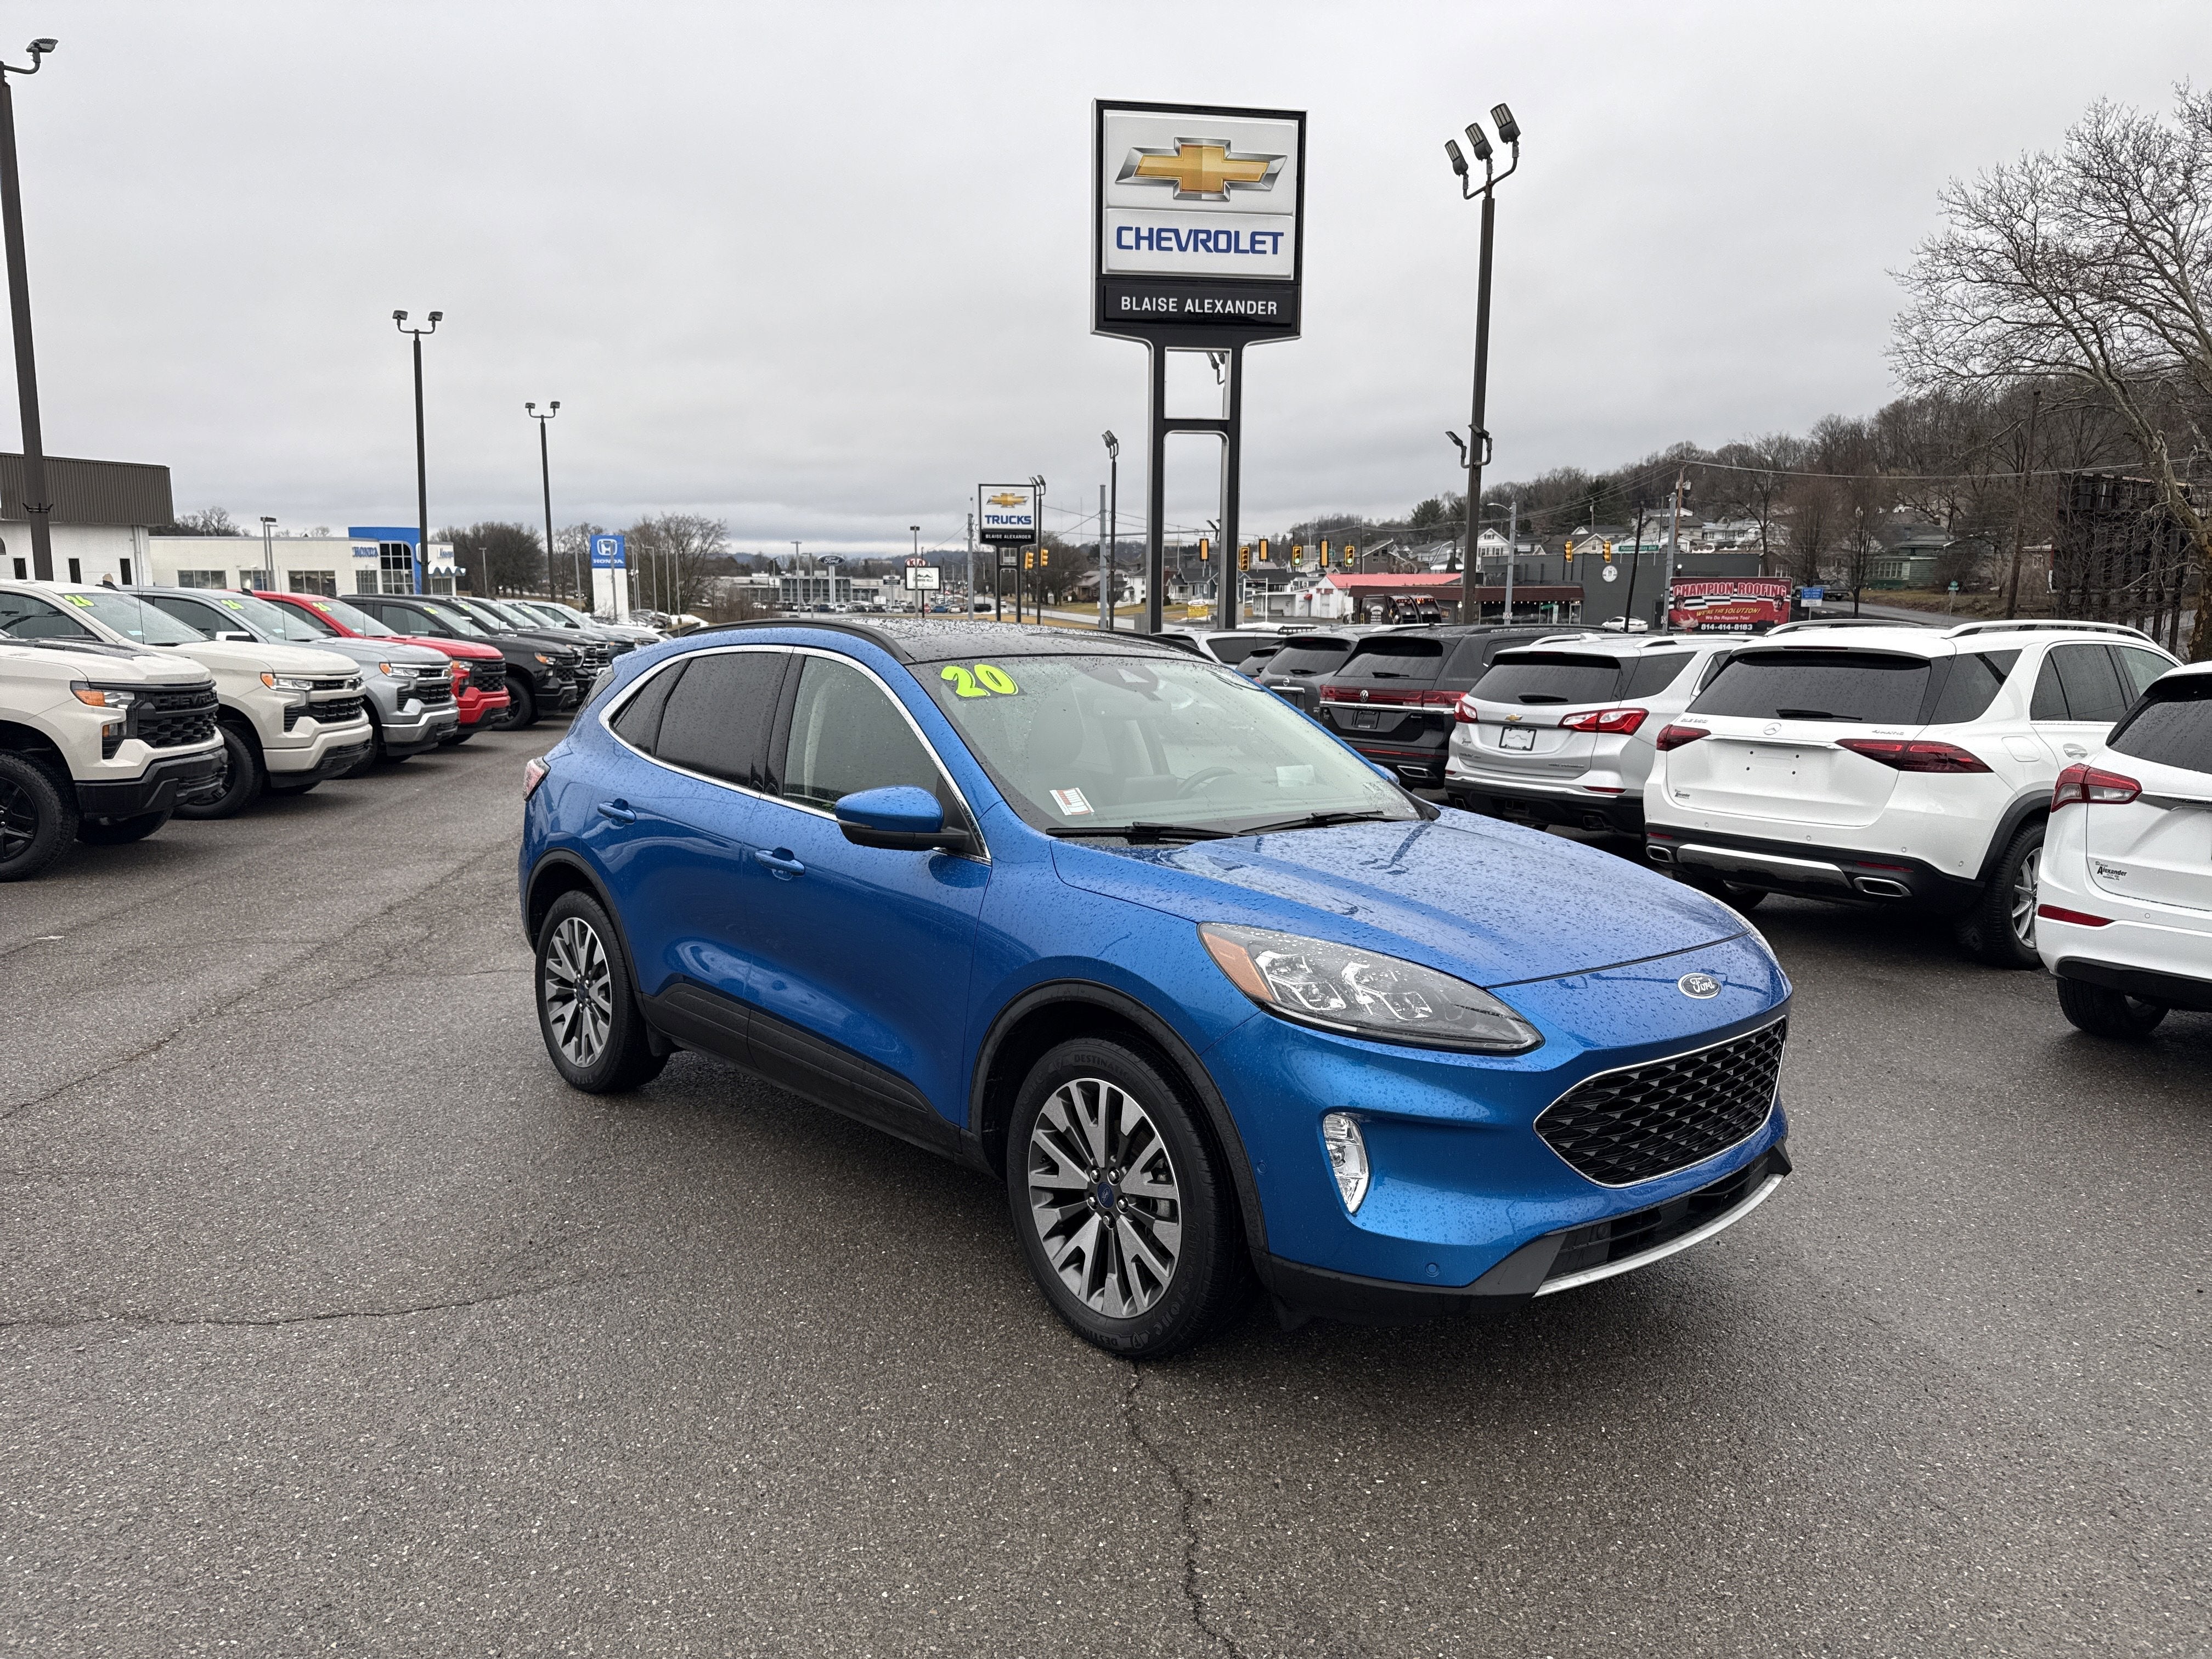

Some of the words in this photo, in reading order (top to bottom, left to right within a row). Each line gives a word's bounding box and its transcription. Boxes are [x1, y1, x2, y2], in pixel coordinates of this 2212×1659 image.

[1116, 226, 1284, 255] CHEVROLET
[1121, 296, 1178, 312] BLAISE
[1184, 299, 1277, 315] ALEXANDER
[985, 515, 1031, 524] TRUCKS
[352, 547, 379, 557] HONDA
[1674, 582, 1734, 597] CHAMPION
[1738, 583, 1787, 598] ROOFING
[941, 664, 1019, 697] 20
[2097, 866, 2128, 877] Alexander
[1690, 977, 1715, 993] Ford
